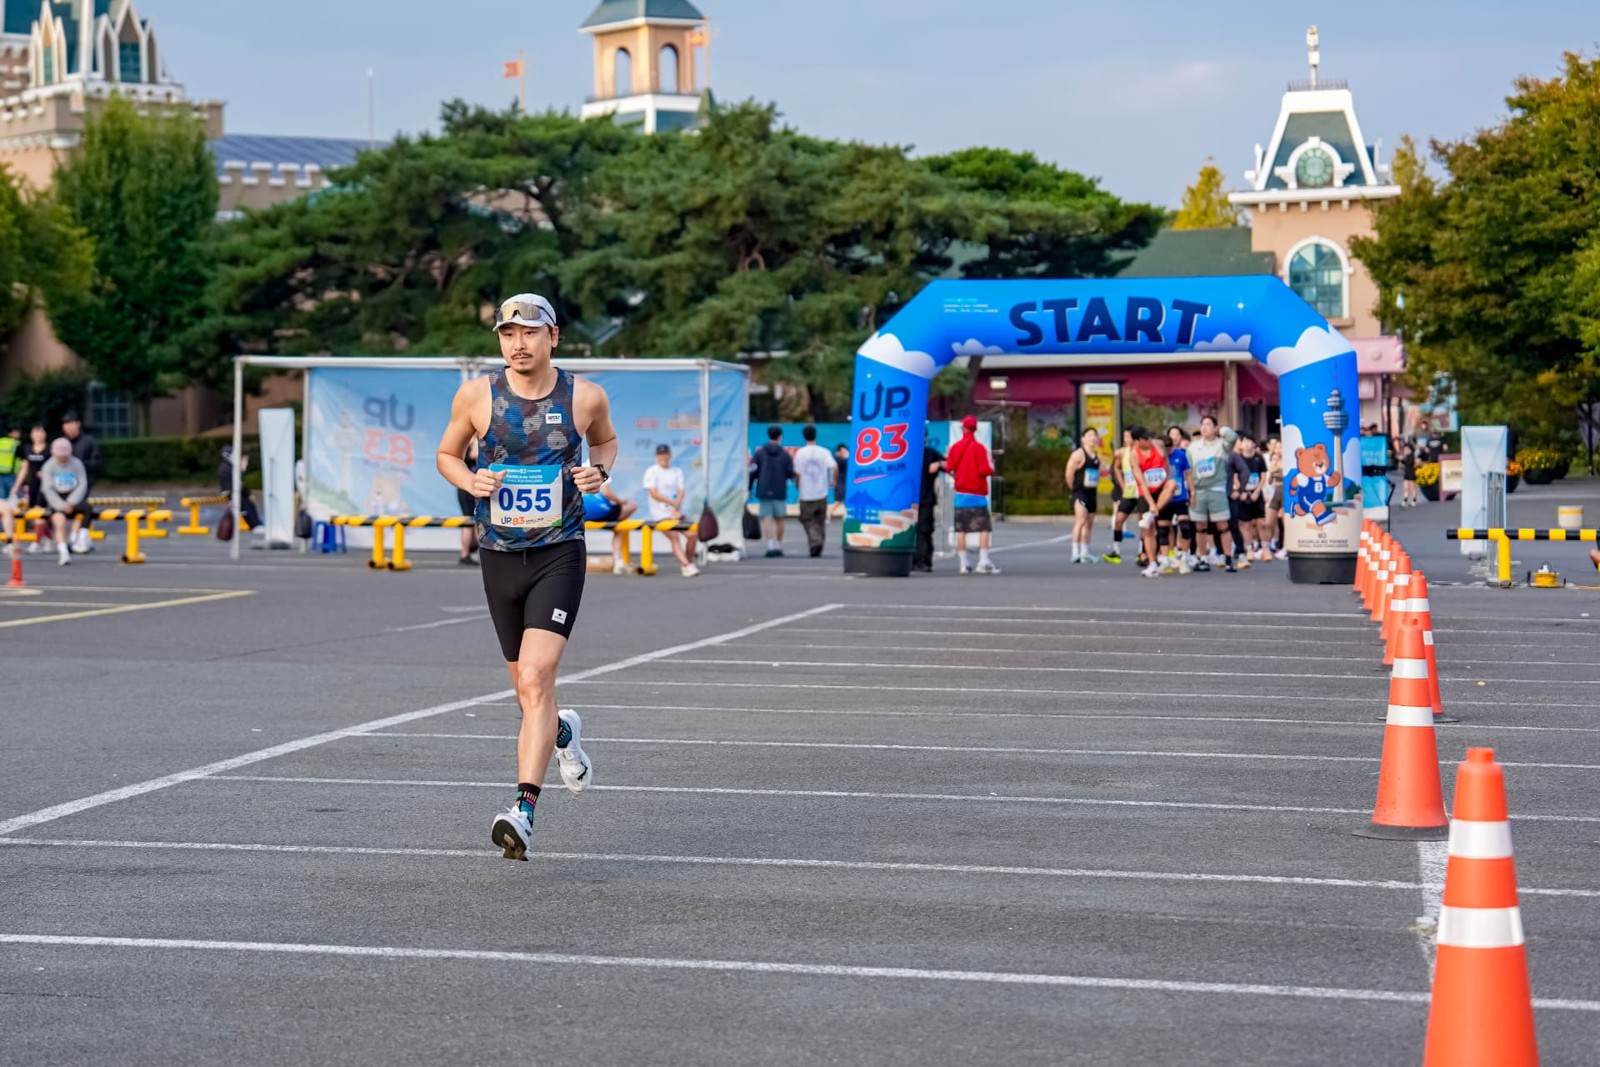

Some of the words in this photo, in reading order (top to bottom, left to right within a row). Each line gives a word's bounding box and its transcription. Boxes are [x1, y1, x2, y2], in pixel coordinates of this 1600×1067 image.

[1009, 296, 1212, 347] START
[859, 380, 911, 422] UP
[855, 422, 910, 466] 83
[498, 487, 552, 512] 055
[512, 516, 525, 526] 83
